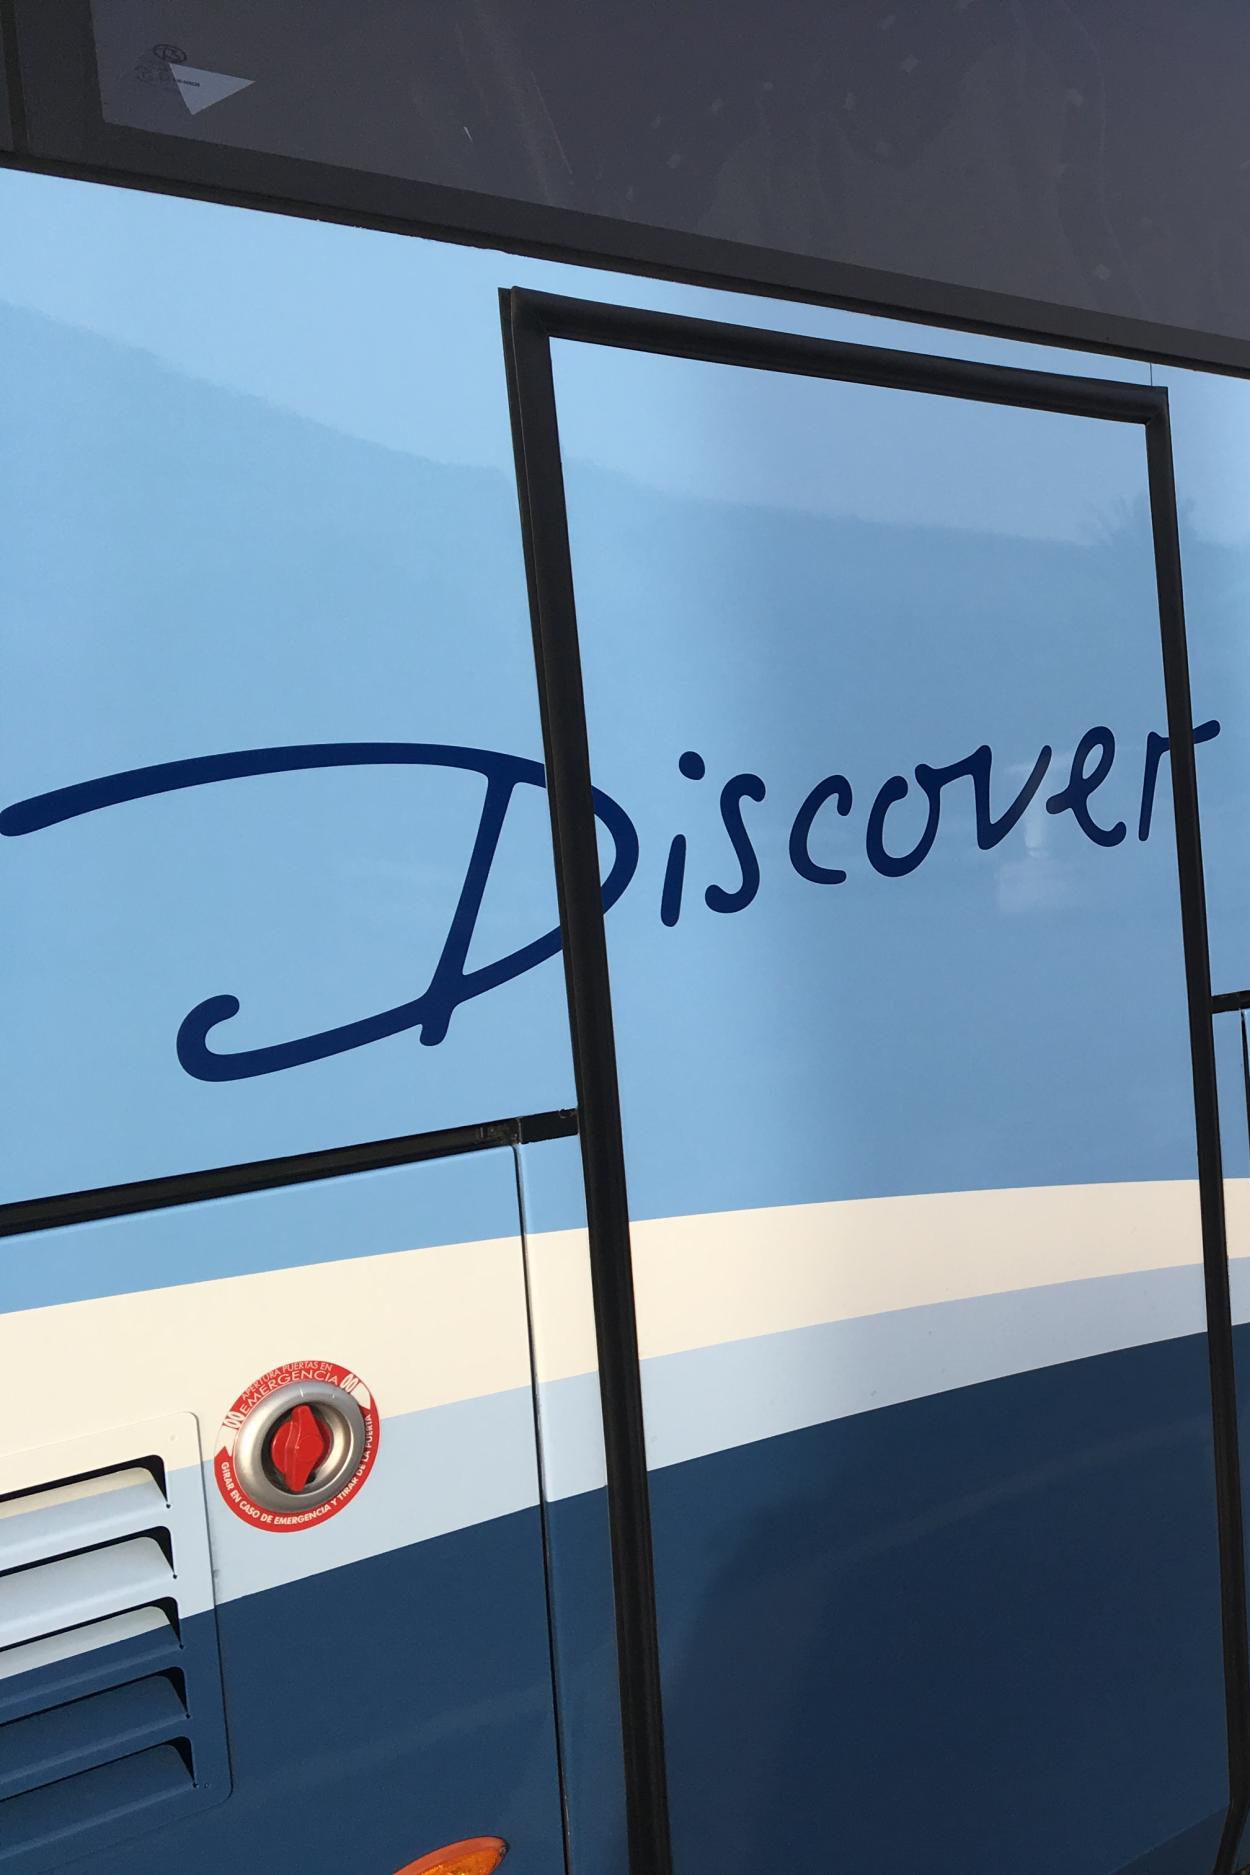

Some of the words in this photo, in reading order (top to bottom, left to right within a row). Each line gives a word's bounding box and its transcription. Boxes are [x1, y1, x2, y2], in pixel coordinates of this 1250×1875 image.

[0, 719, 1221, 1083] Discover
[241, 1368, 282, 1400] APERTURA
[282, 1361, 319, 1373] PUERTAS
[319, 1362, 333, 1372] EN
[239, 1370, 339, 1415] EMERGENCIA
[364, 1414, 374, 1449] PUERTA
[362, 1450, 371, 1463] LA
[221, 1461, 235, 1491] GIRAR
[356, 1463, 367, 1477] DE
[230, 1490, 242, 1503] EN
[337, 1477, 359, 1500] TIRAR
[239, 1501, 261, 1518] CASO
[330, 1498, 338, 1506] Y
[260, 1513, 274, 1524] DE
[273, 1504, 332, 1525] EMERGENCIA
